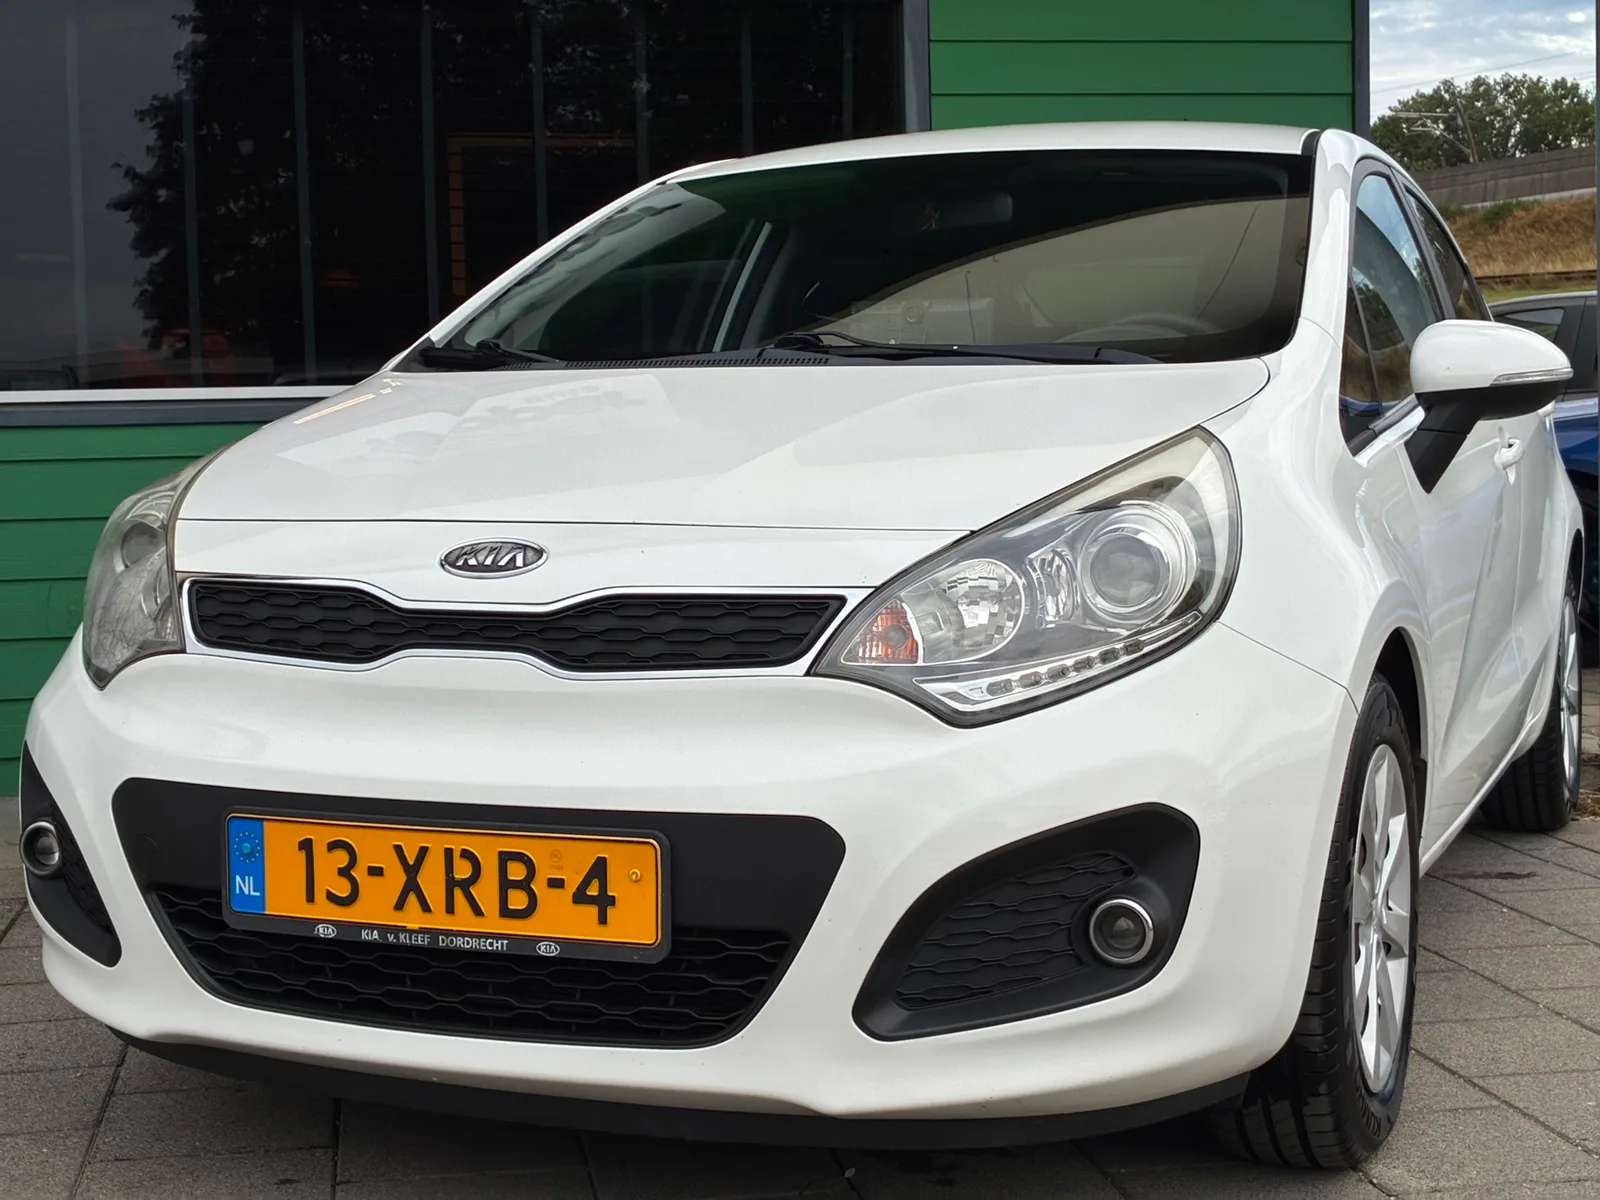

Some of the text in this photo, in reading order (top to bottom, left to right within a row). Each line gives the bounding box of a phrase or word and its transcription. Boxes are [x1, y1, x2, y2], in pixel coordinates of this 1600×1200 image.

[455, 544, 526, 568] KIA
[235, 874, 261, 896] NL
[298, 837, 616, 926] 13-XRB-4
[361, 928, 380, 941] KIA
[400, 931, 431, 946] KLEEF
[438, 935, 508, 951] DORDRECHT
